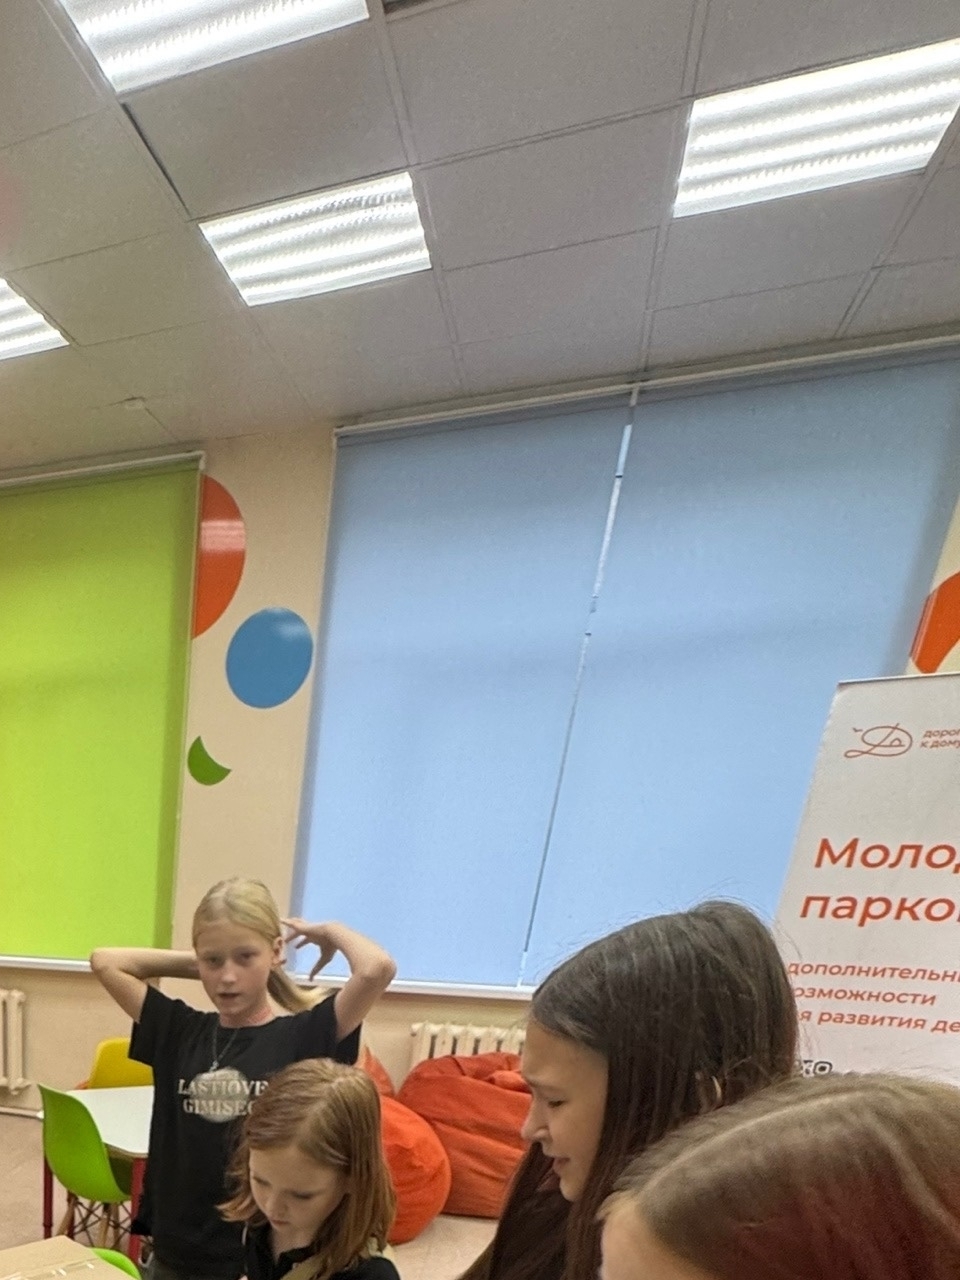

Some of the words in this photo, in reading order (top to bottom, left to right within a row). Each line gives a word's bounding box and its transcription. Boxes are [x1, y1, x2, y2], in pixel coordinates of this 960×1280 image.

[814, 837, 960, 874] Моло
[800, 895, 960, 928] парко
[793, 987, 937, 1006] озможности
[817, 1011, 927, 1029] развития
[930, 1019, 960, 1033] де
